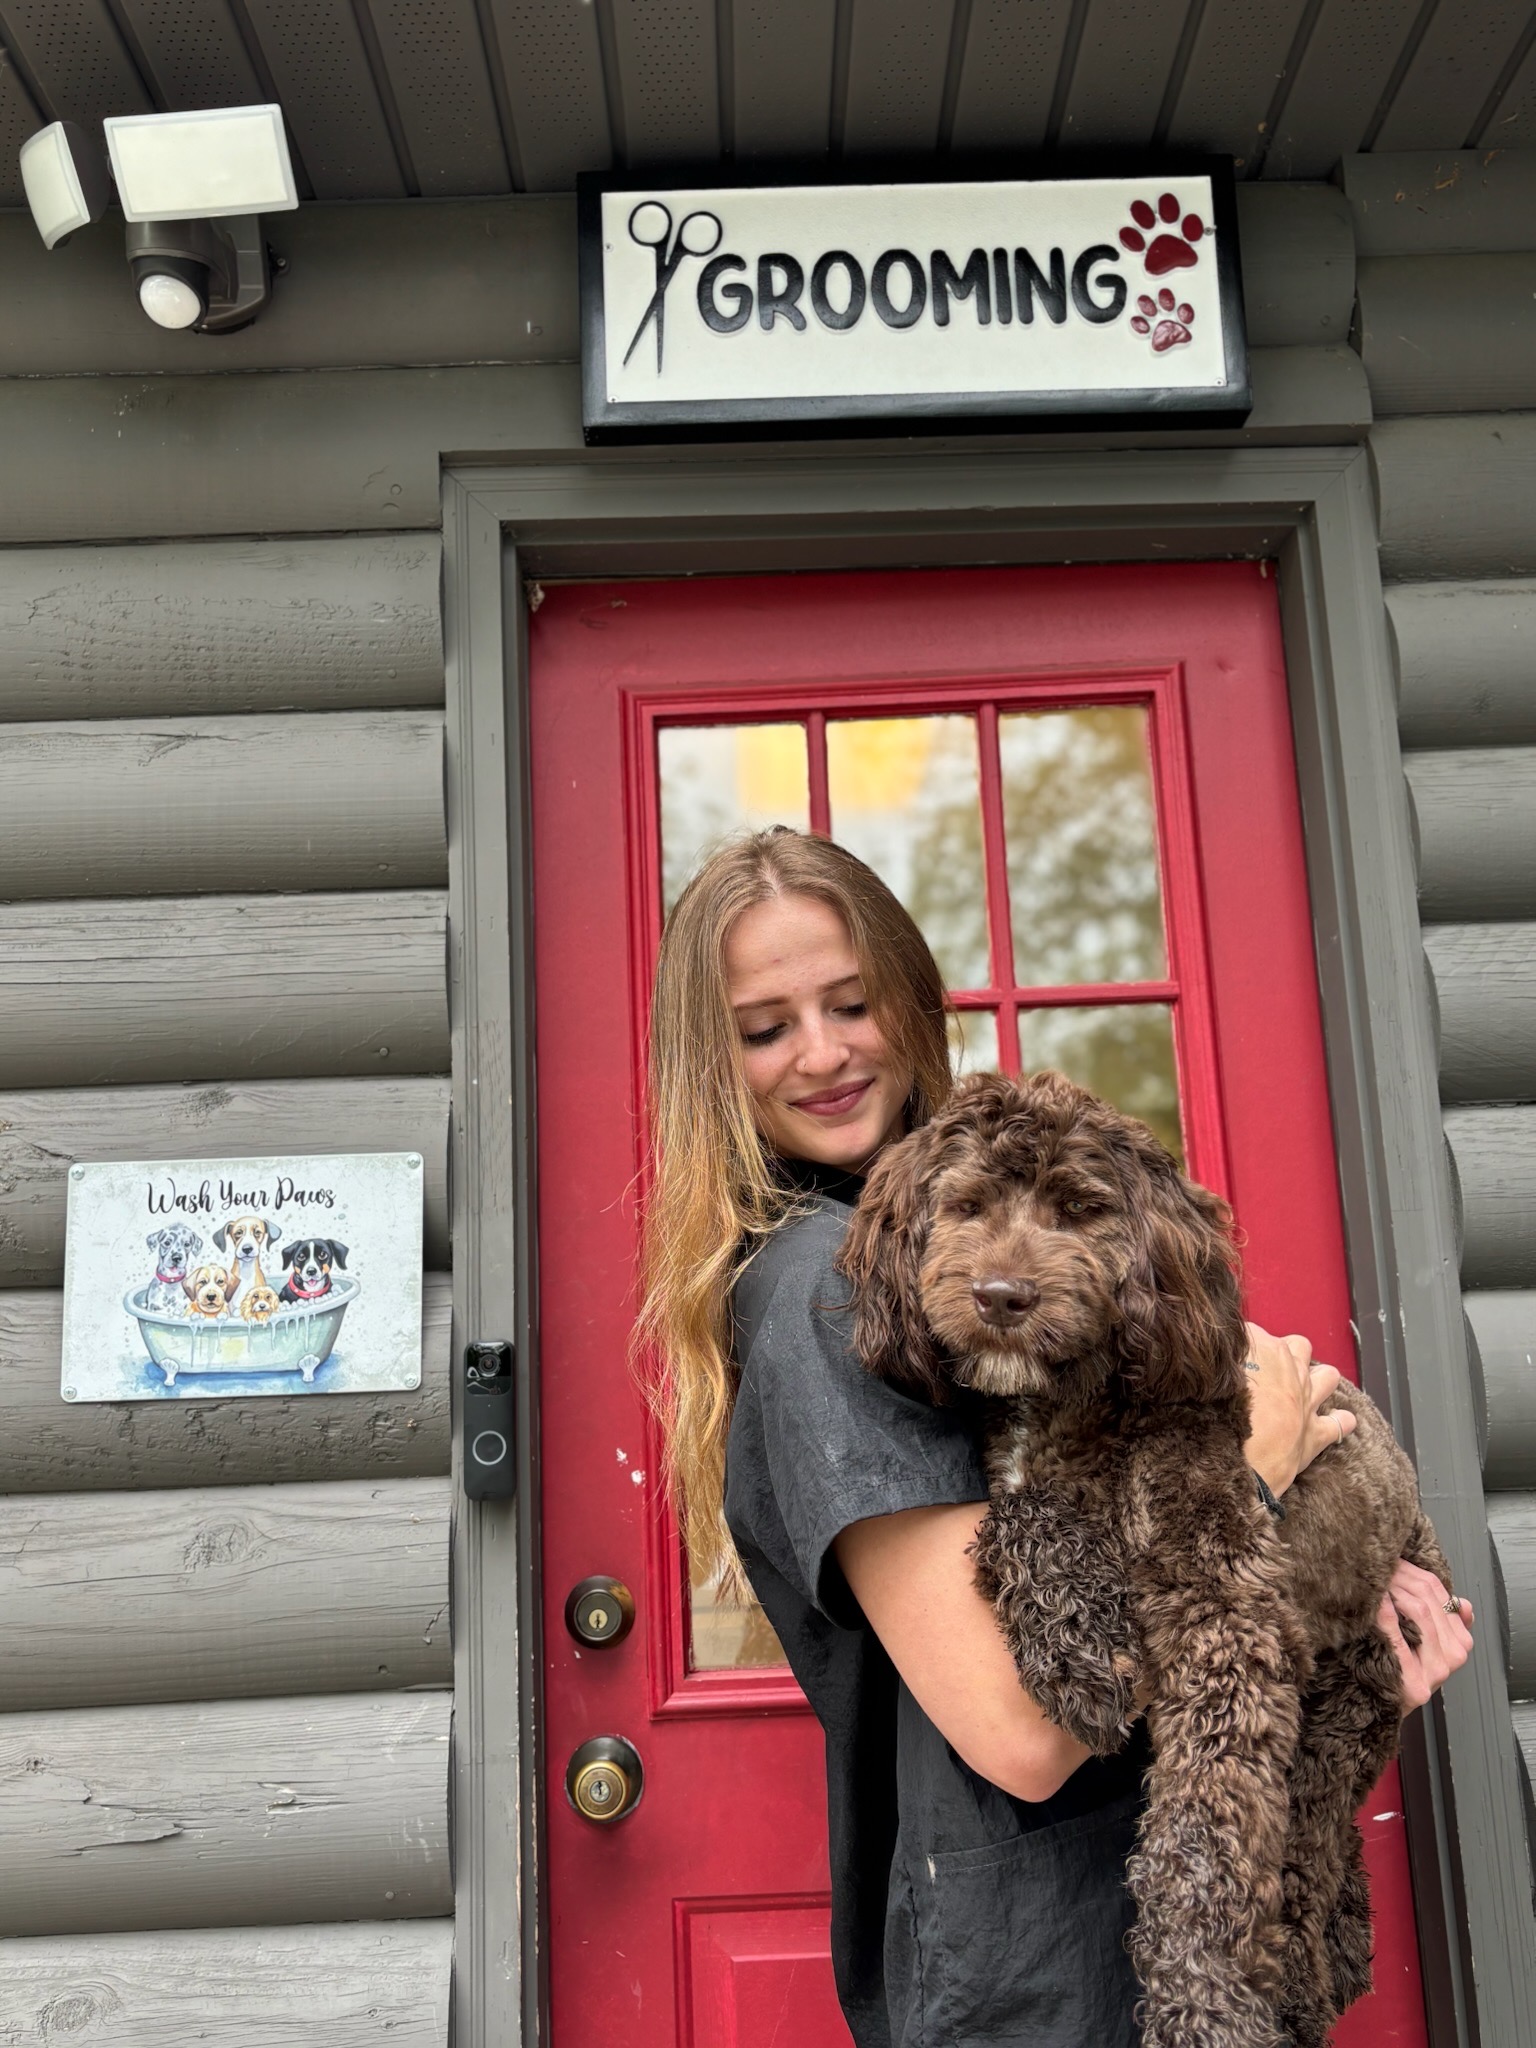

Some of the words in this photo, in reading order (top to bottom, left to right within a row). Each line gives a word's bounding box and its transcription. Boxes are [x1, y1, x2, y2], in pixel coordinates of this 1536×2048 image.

[697, 245, 1127, 333] GROOMING
[147, 1177, 214, 1214] Wash
[219, 1179, 270, 1211] Your
[275, 1176, 336, 1211] Paws
